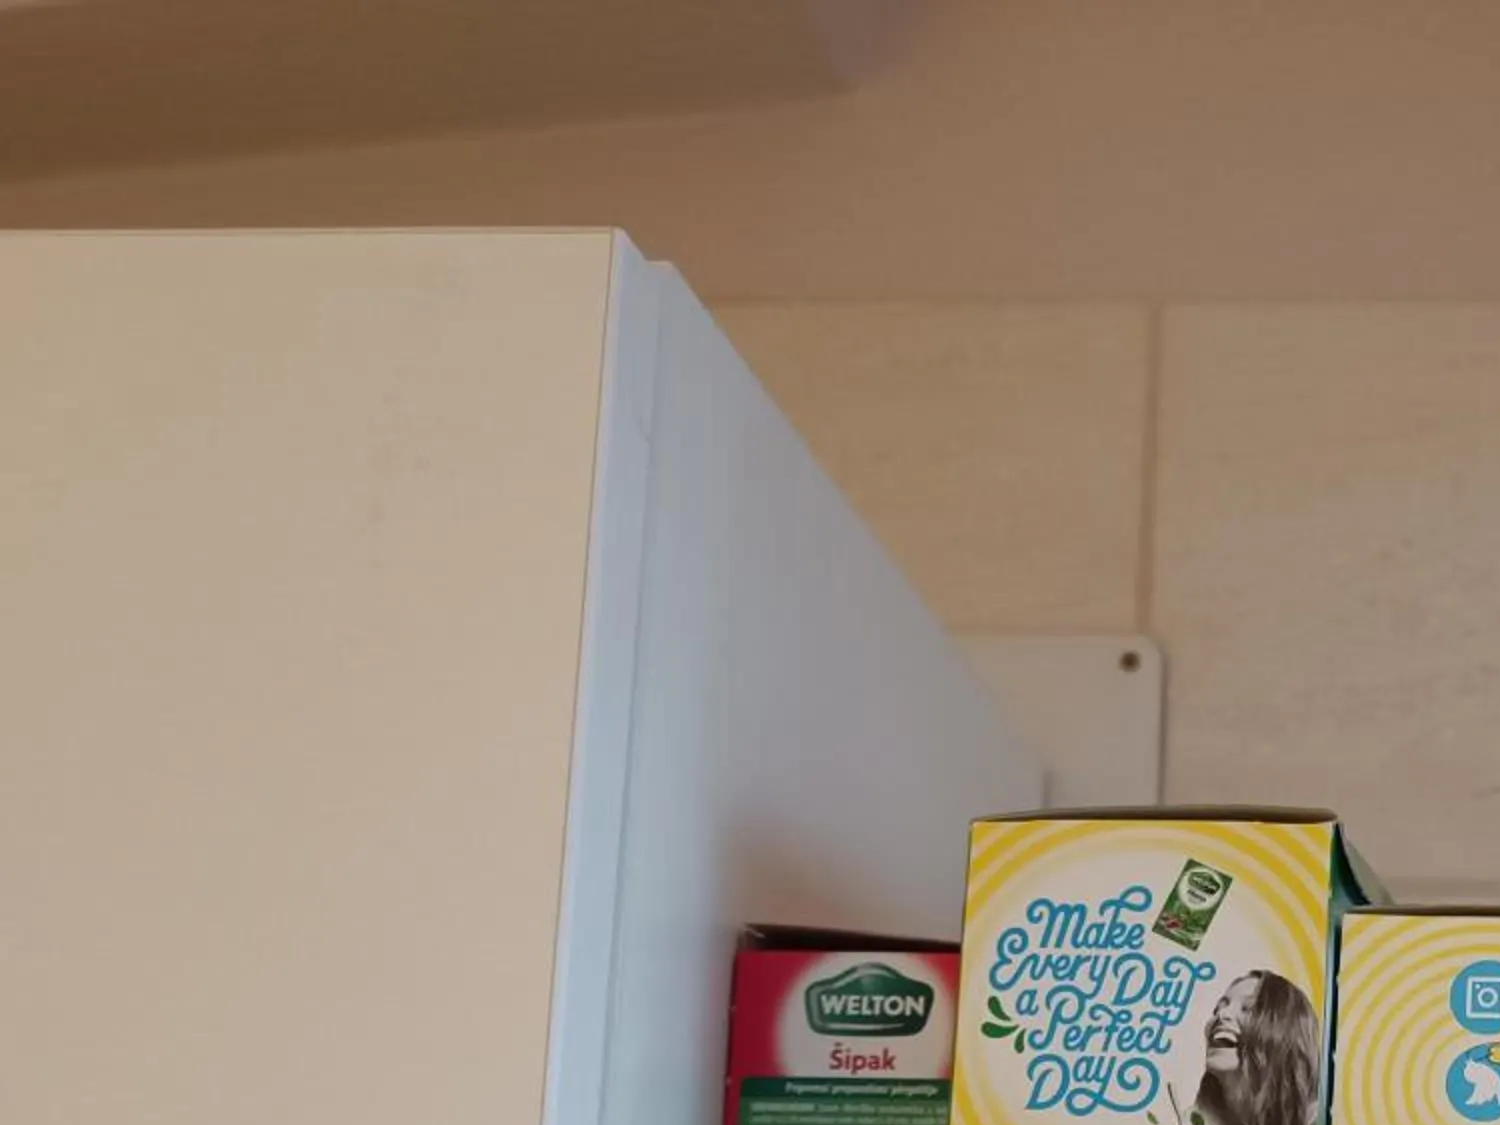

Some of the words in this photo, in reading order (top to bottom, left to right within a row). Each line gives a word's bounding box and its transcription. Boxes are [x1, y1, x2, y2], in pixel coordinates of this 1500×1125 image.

[1026, 885, 1153, 951] Make
[820, 994, 927, 1017] WELTON
[989, 927, 1111, 996] Every
[1112, 951, 1217, 1026] Day
[1015, 988, 1039, 1017] a
[1027, 984, 1172, 1053] Perfect
[829, 1042, 896, 1074] Šipak
[1025, 1052, 1160, 1117] Day
